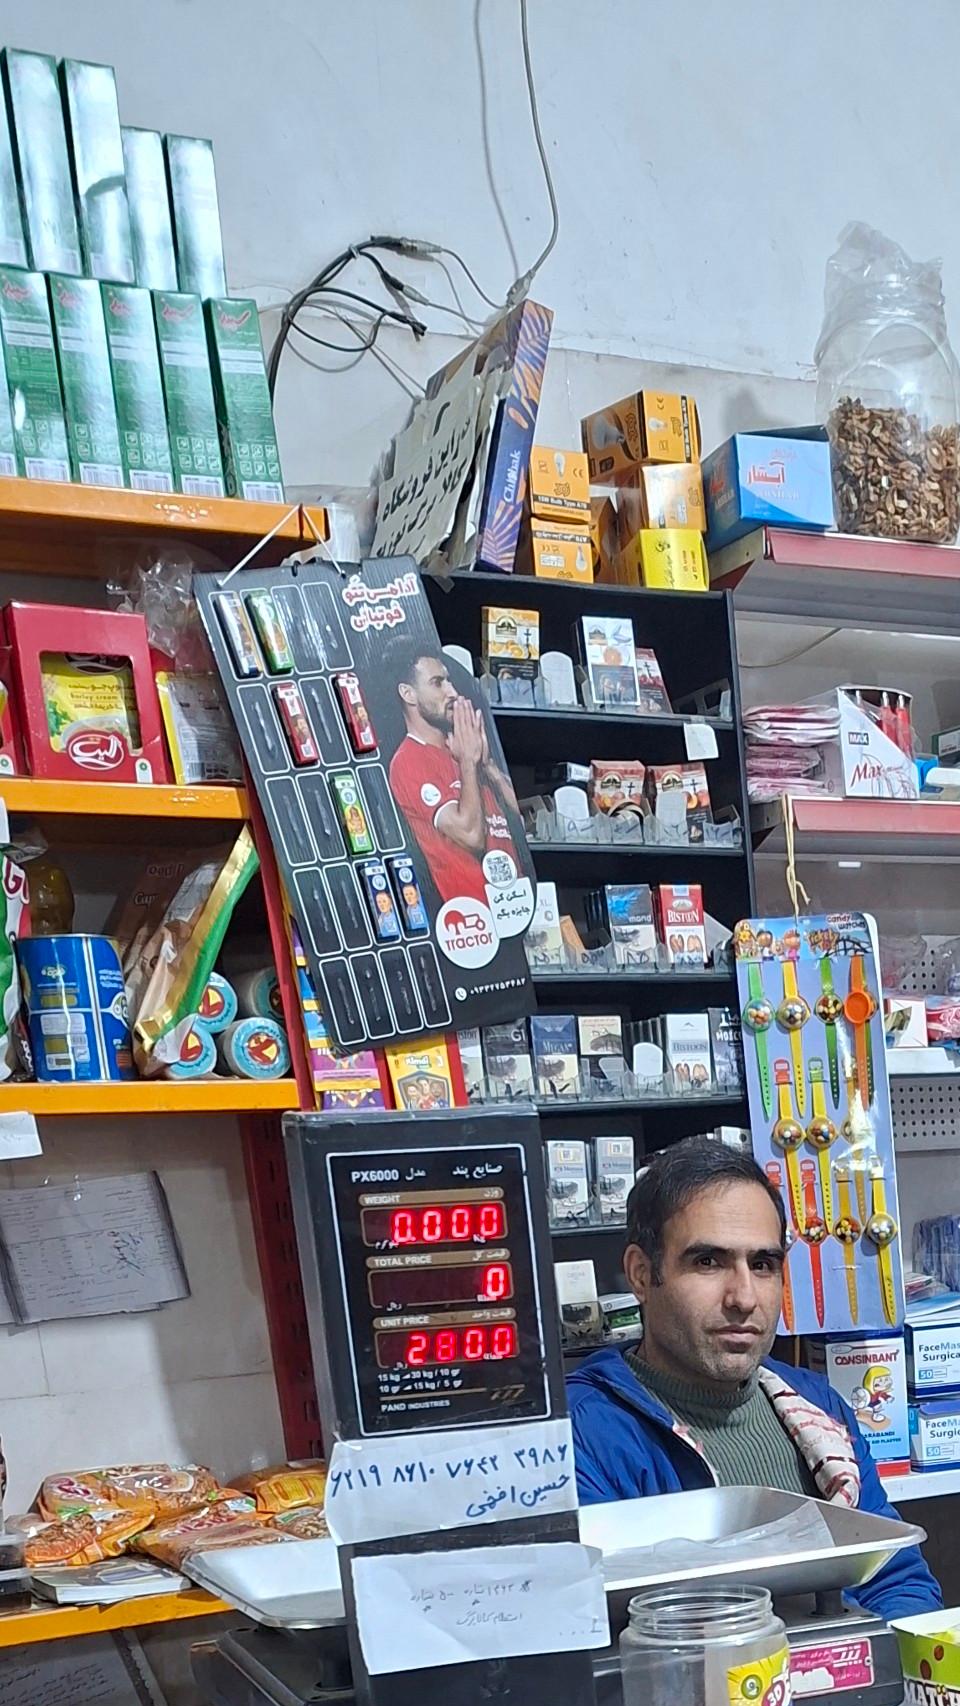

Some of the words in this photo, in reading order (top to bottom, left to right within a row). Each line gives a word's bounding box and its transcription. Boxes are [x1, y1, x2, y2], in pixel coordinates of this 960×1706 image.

[367, 573, 418, 602] آدامس
[849, 732, 868, 744] MAX
[850, 763, 882, 787] Max
[628, 914, 652, 923] mond
[351, 1169, 399, 1183] PX6000
[405, 1168, 426, 1181] مدل
[452, 1165, 469, 1179] پند
[472, 1162, 503, 1179] صنایع
[364, 1195, 400, 1204] WEIGHT
[374, 1256, 402, 1267] TOTAL
[405, 1255, 433, 1265] PRICE
[486, 1266, 505, 1300] 0
[380, 1317, 402, 1327] UNIT
[403, 1315, 430, 1325] PRICE
[378, 1373, 389, 1382] 15
[389, 1373, 401, 1383] kg
[411, 1372, 422, 1380] 30
[422, 1371, 434, 1379] kg
[919, 1370, 933, 1379] 50
[379, 1385, 389, 1393] 10
[381, 1403, 406, 1412] PAND
[408, 1400, 450, 1410] INDUSTRIES
[927, 1447, 940, 1457] 50
[520, 1473, 570, 1507] حسین
